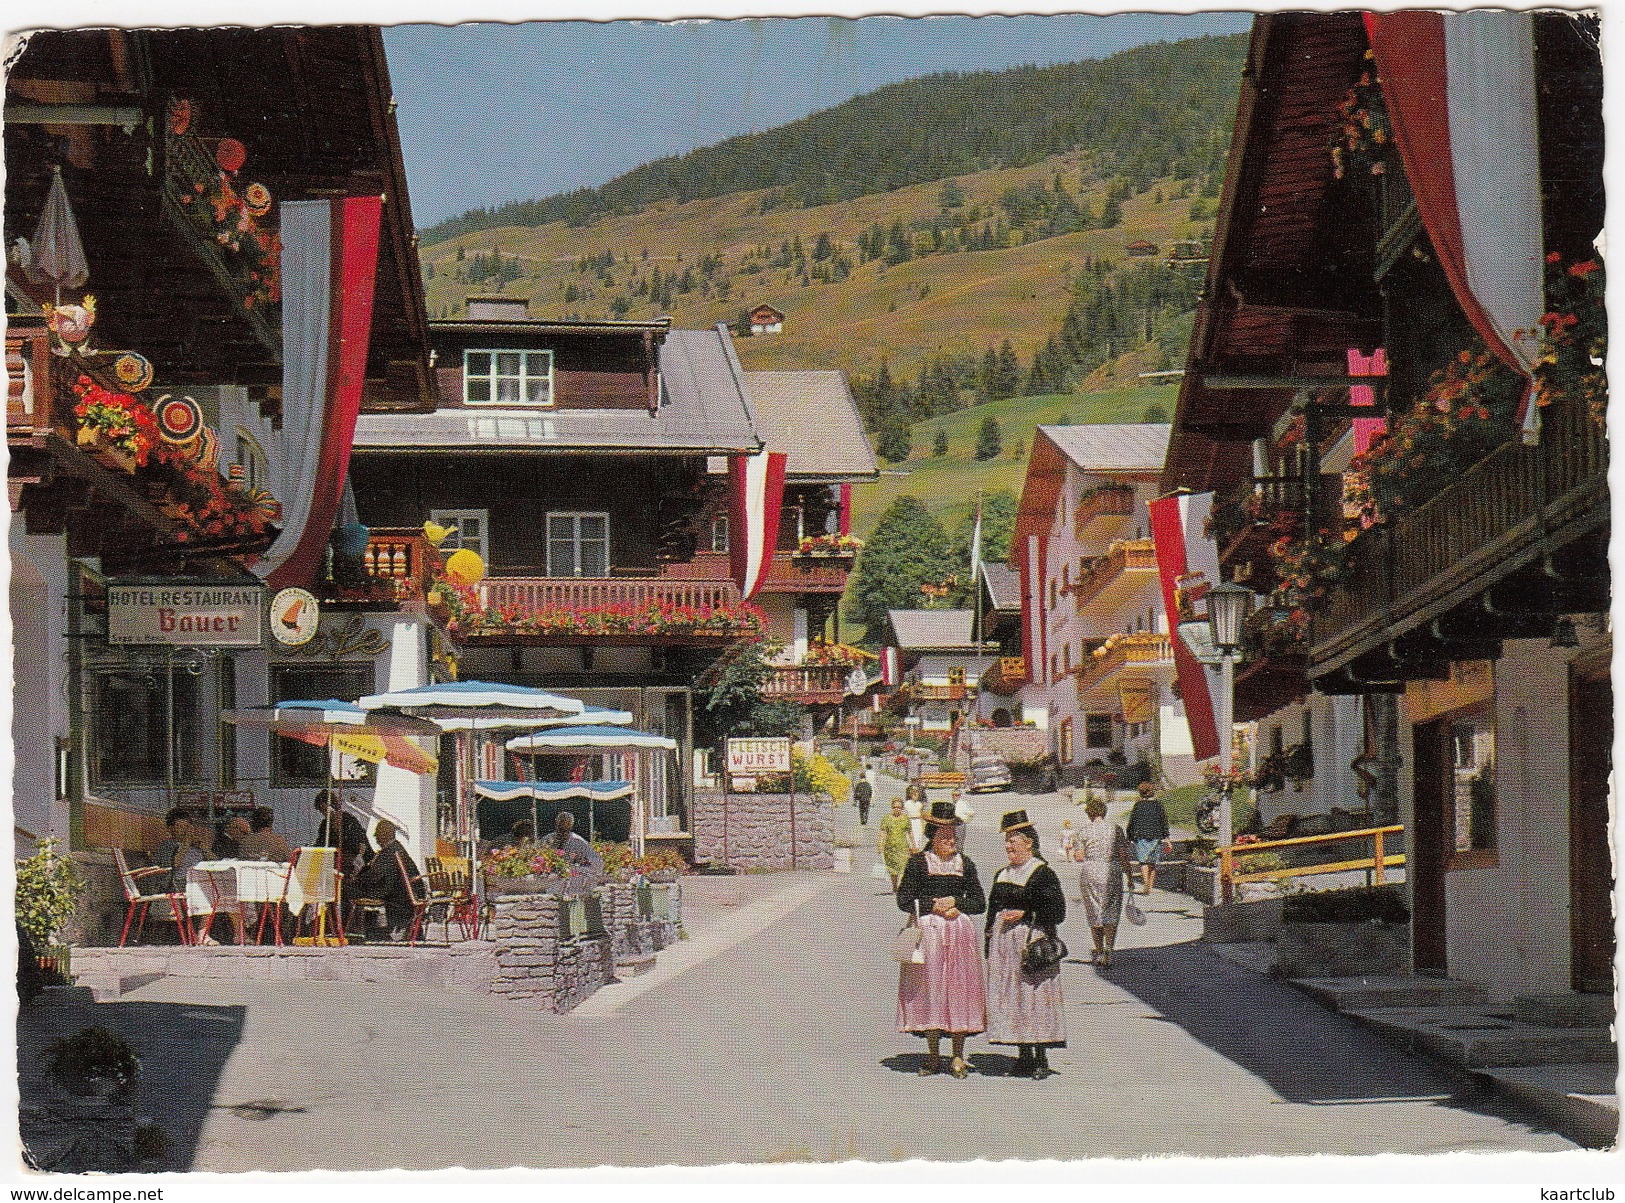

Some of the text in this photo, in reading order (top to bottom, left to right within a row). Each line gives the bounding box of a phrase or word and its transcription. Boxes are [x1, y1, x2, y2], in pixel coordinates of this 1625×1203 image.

[158, 606, 240, 632] Bauer
[729, 740, 788, 753] FLEISCH
[733, 754, 785, 766] WURST
